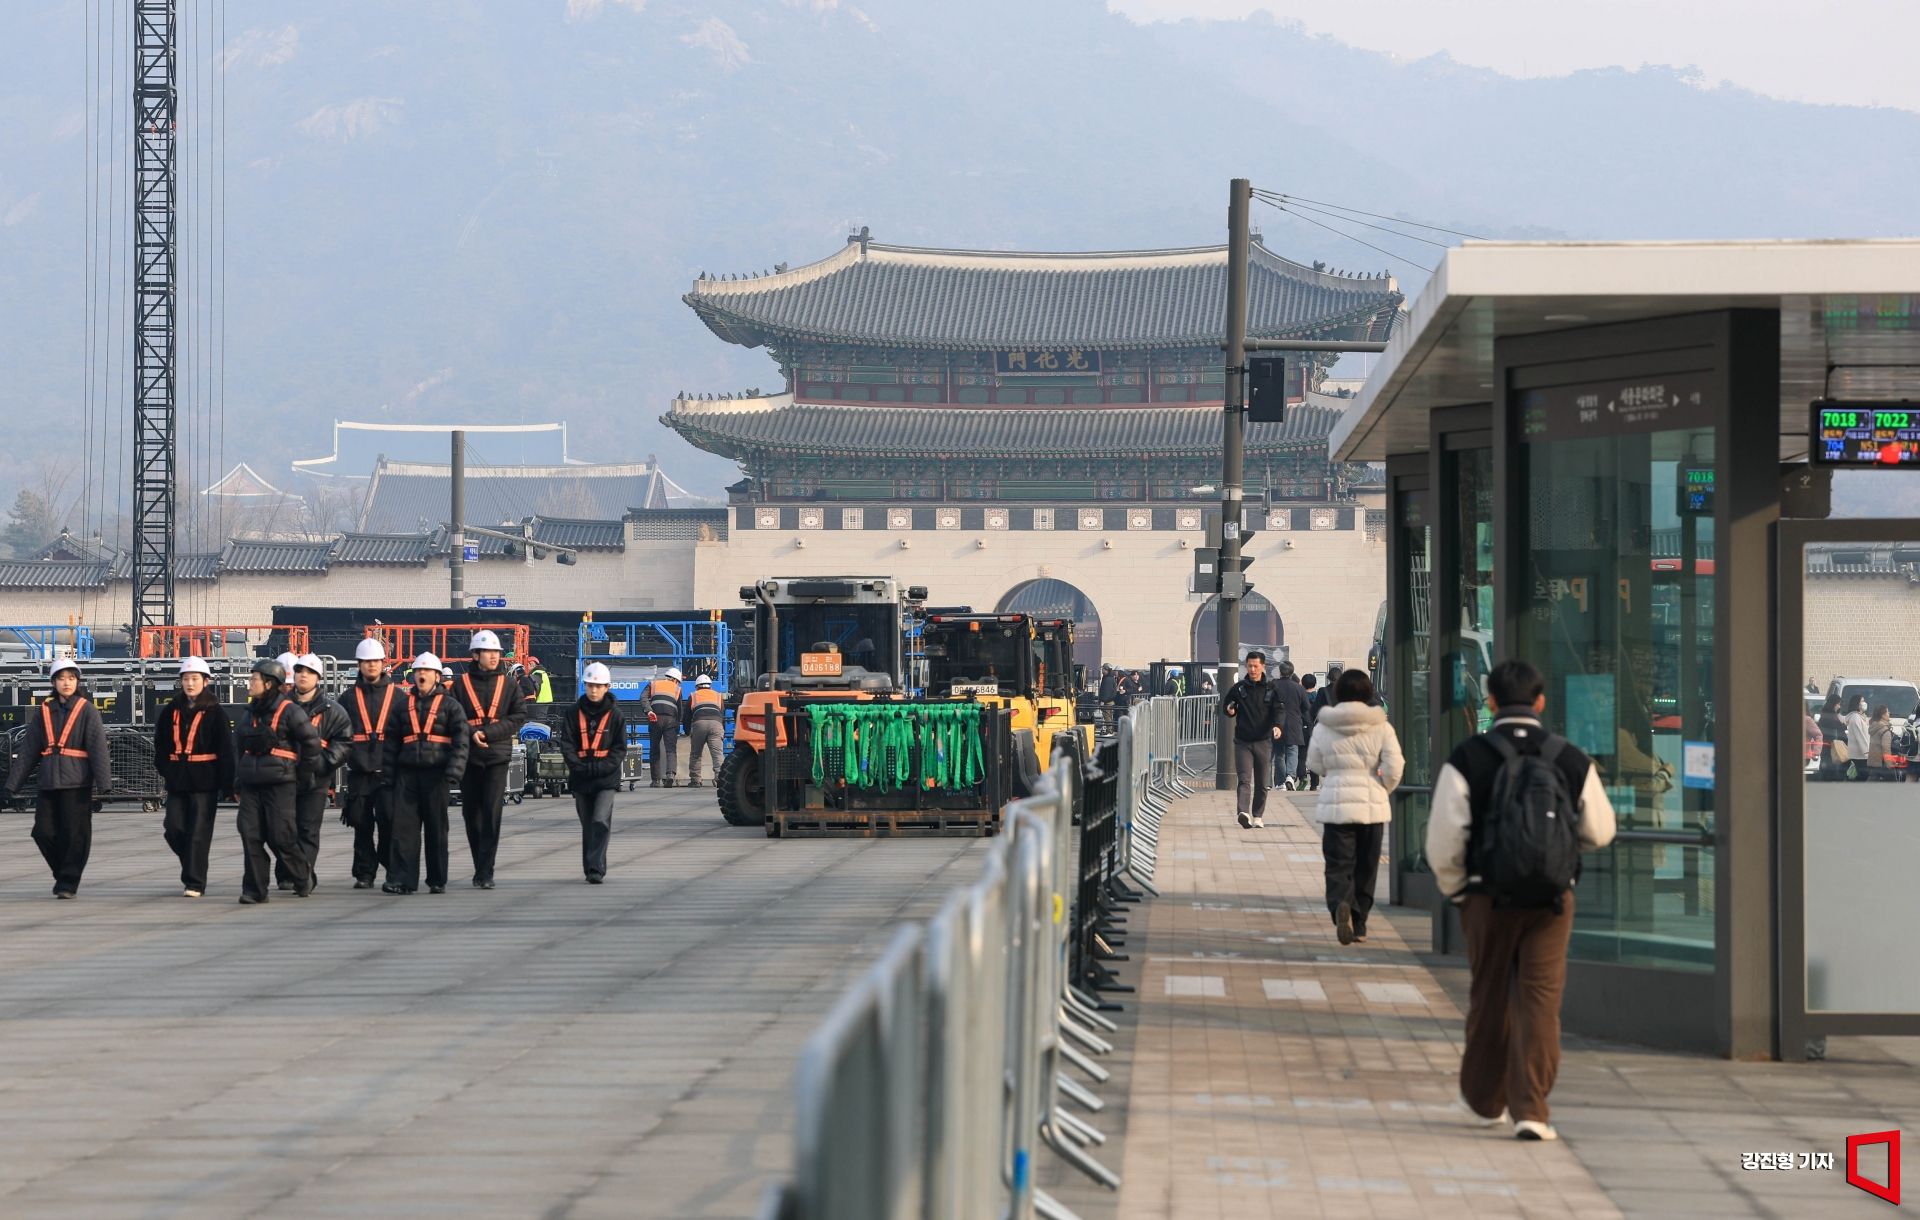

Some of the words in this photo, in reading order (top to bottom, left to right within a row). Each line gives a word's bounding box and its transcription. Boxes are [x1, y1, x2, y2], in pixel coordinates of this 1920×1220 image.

[1823, 413, 1857, 427] 7018
[1875, 413, 1909, 427] 7022
[1827, 441, 1844, 451] 704
[1687, 471, 1714, 483] 7018
